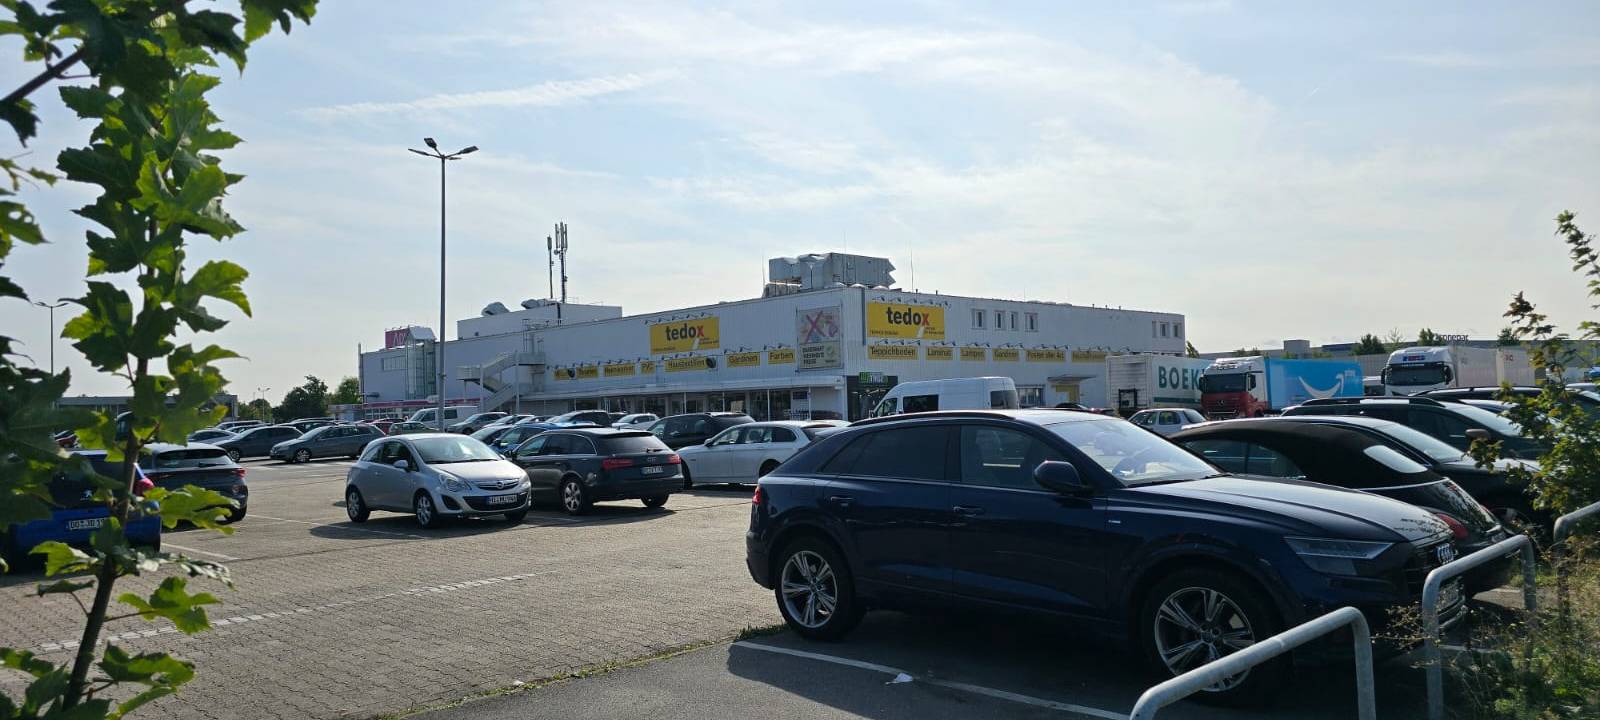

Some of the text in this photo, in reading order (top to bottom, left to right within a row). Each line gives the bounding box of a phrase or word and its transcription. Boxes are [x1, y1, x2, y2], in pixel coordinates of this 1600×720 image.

[886, 306, 930, 326] tedox
[665, 322, 704, 341] tedox
[769, 350, 794, 360] Farben
[1158, 365, 1204, 391] BOEK
